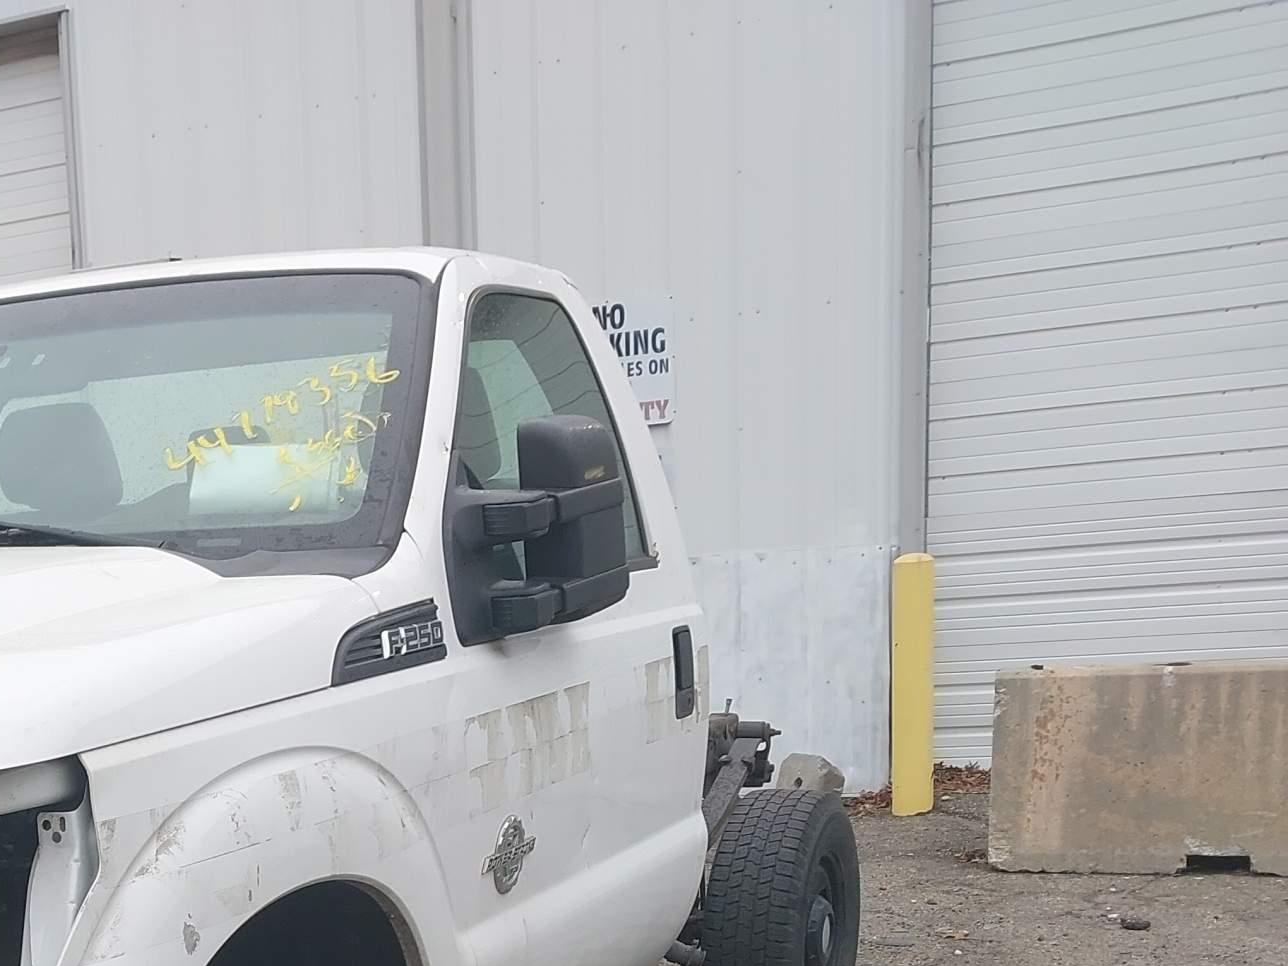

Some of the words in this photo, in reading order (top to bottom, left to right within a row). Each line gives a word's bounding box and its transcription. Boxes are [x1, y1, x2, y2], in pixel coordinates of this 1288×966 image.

[592, 303, 625, 330] NO
[621, 360, 643, 377] ES
[648, 357, 669, 375] ON
